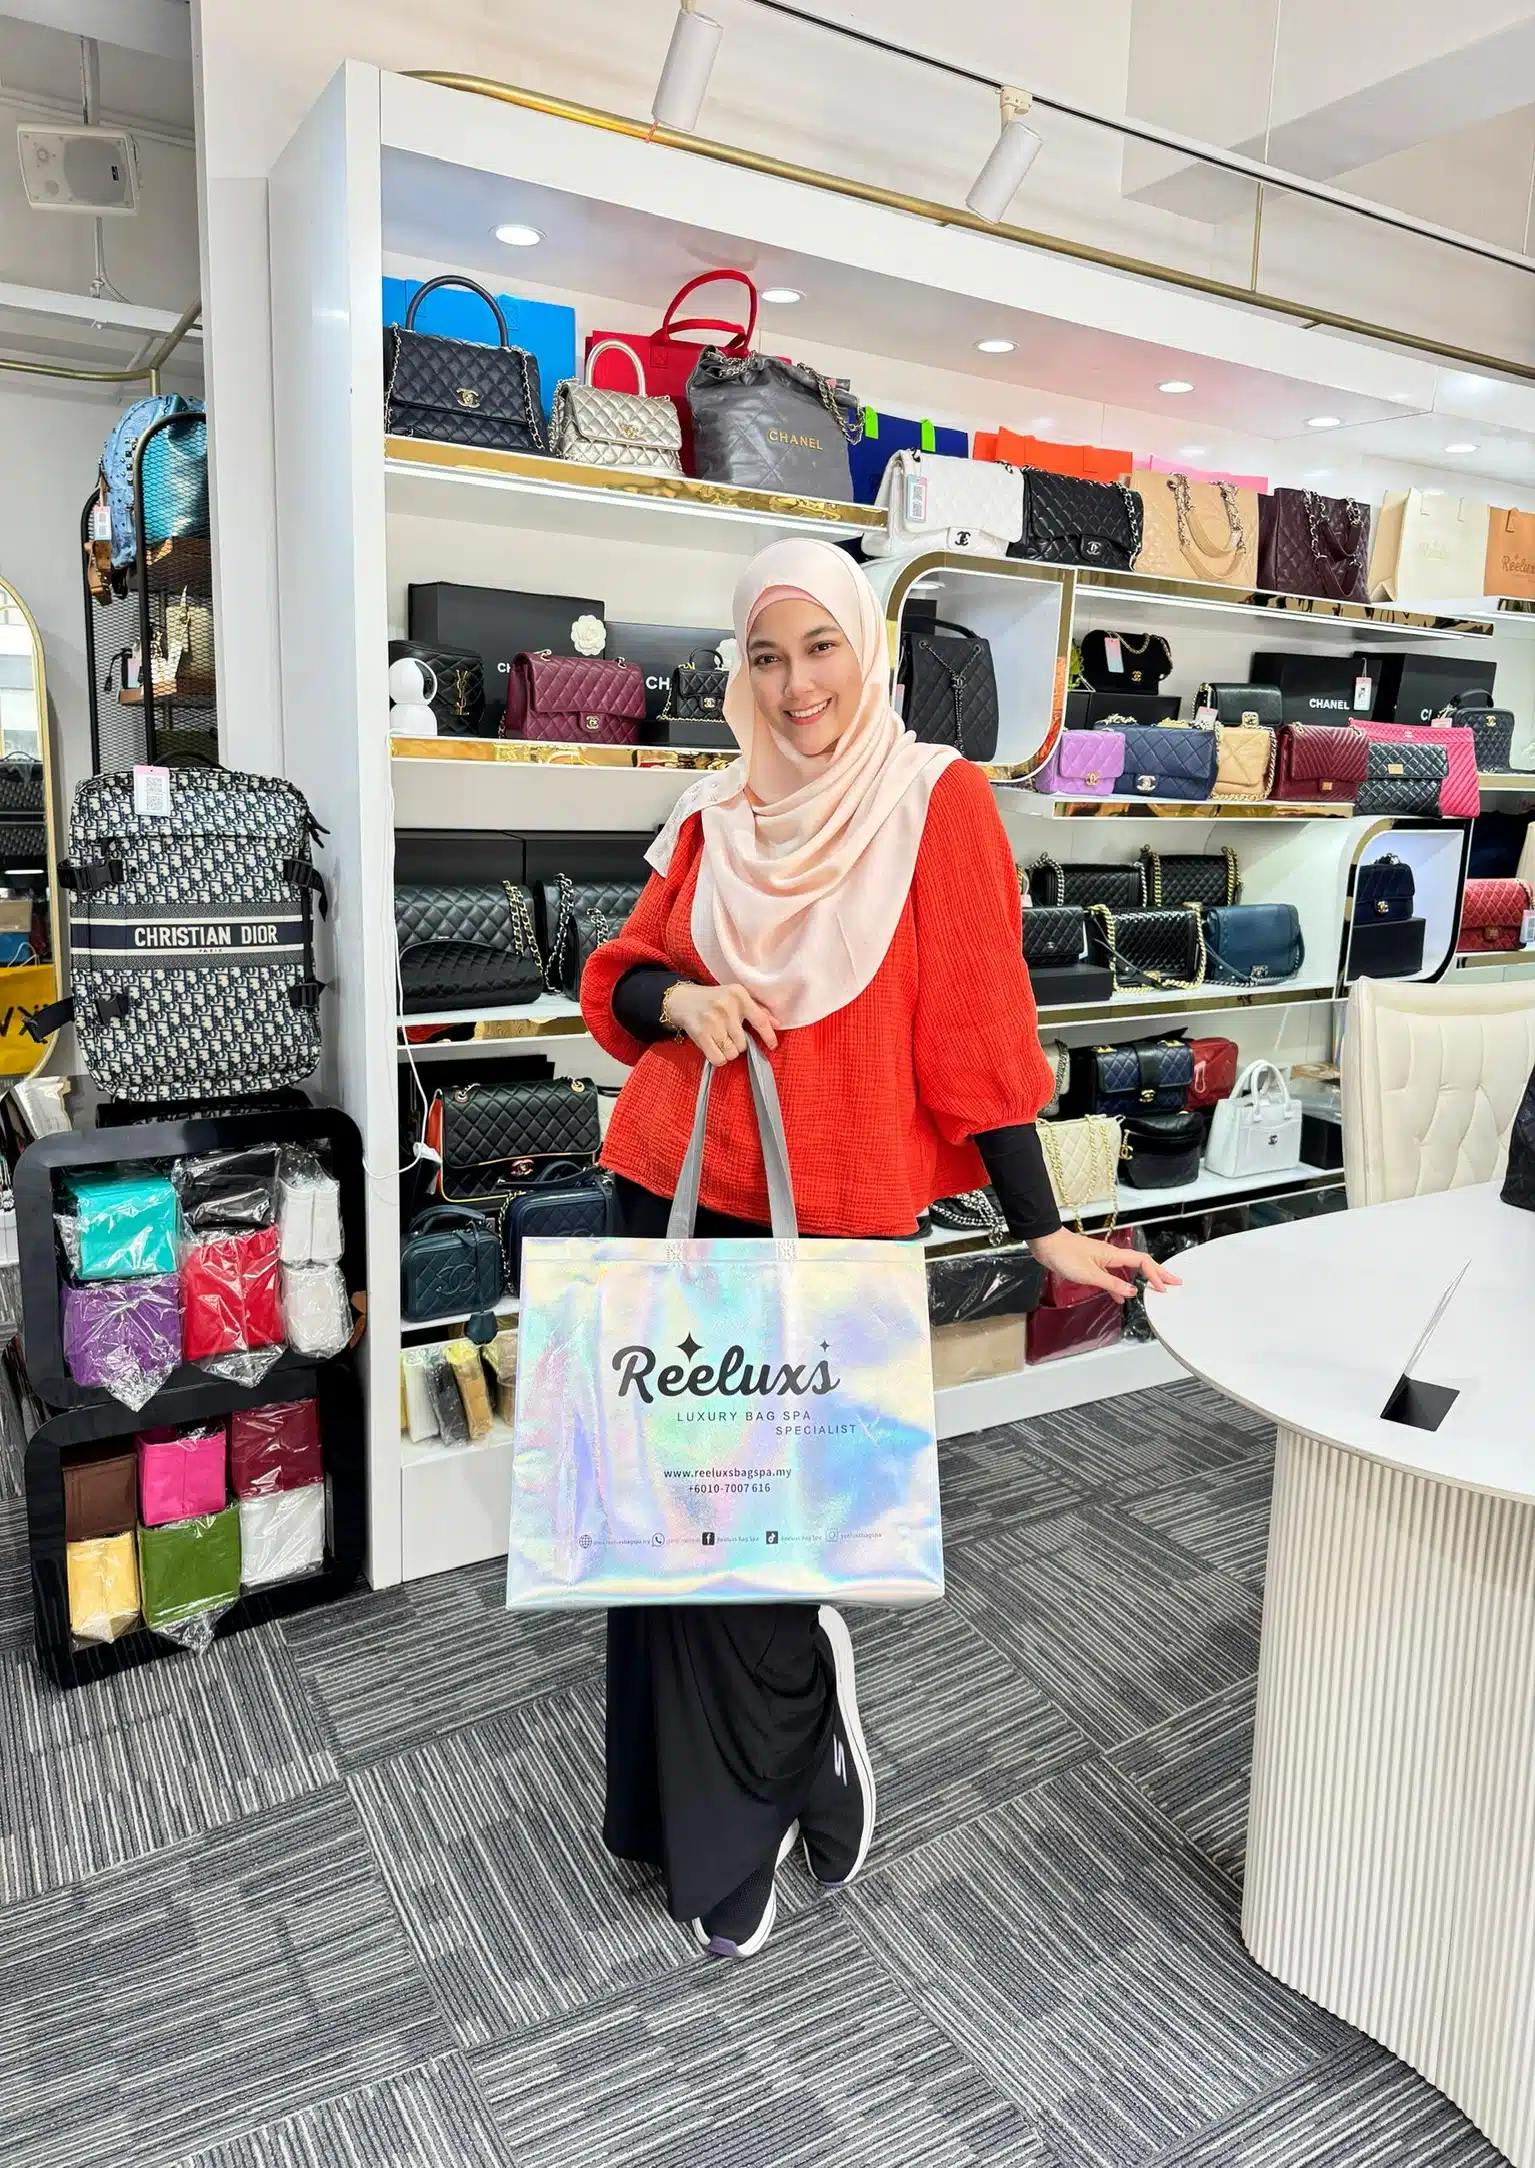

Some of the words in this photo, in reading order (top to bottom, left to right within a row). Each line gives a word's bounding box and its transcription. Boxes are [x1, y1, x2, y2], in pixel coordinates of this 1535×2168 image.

[768, 430, 824, 451] CHANEL
[1309, 697, 1350, 711] CHANEL
[134, 926, 232, 947] CHRISTIAN
[241, 924, 279, 945] DIOR
[612, 1344, 841, 1404] Reeluxs
[677, 1411, 738, 1422] LUXURY
[745, 1411, 776, 1422] BAG
[783, 1410, 811, 1421] SPA
[775, 1424, 857, 1436] SPECIALIST
[664, 1467, 792, 1480] www.reeluxsbagspa.my
